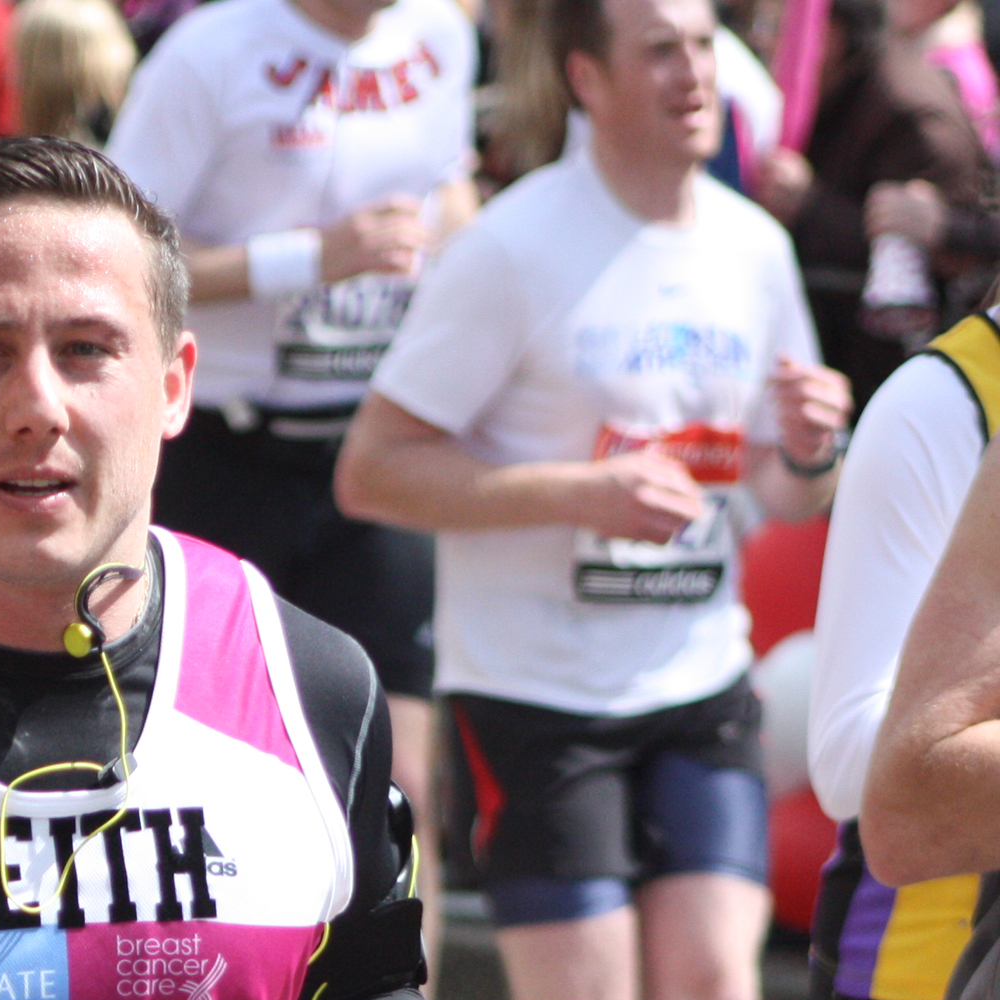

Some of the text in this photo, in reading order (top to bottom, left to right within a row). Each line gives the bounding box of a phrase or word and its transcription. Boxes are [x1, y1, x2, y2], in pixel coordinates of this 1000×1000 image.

[116, 933, 202, 956] breast
[116, 958, 209, 976] cancer
[116, 978, 175, 996] care
